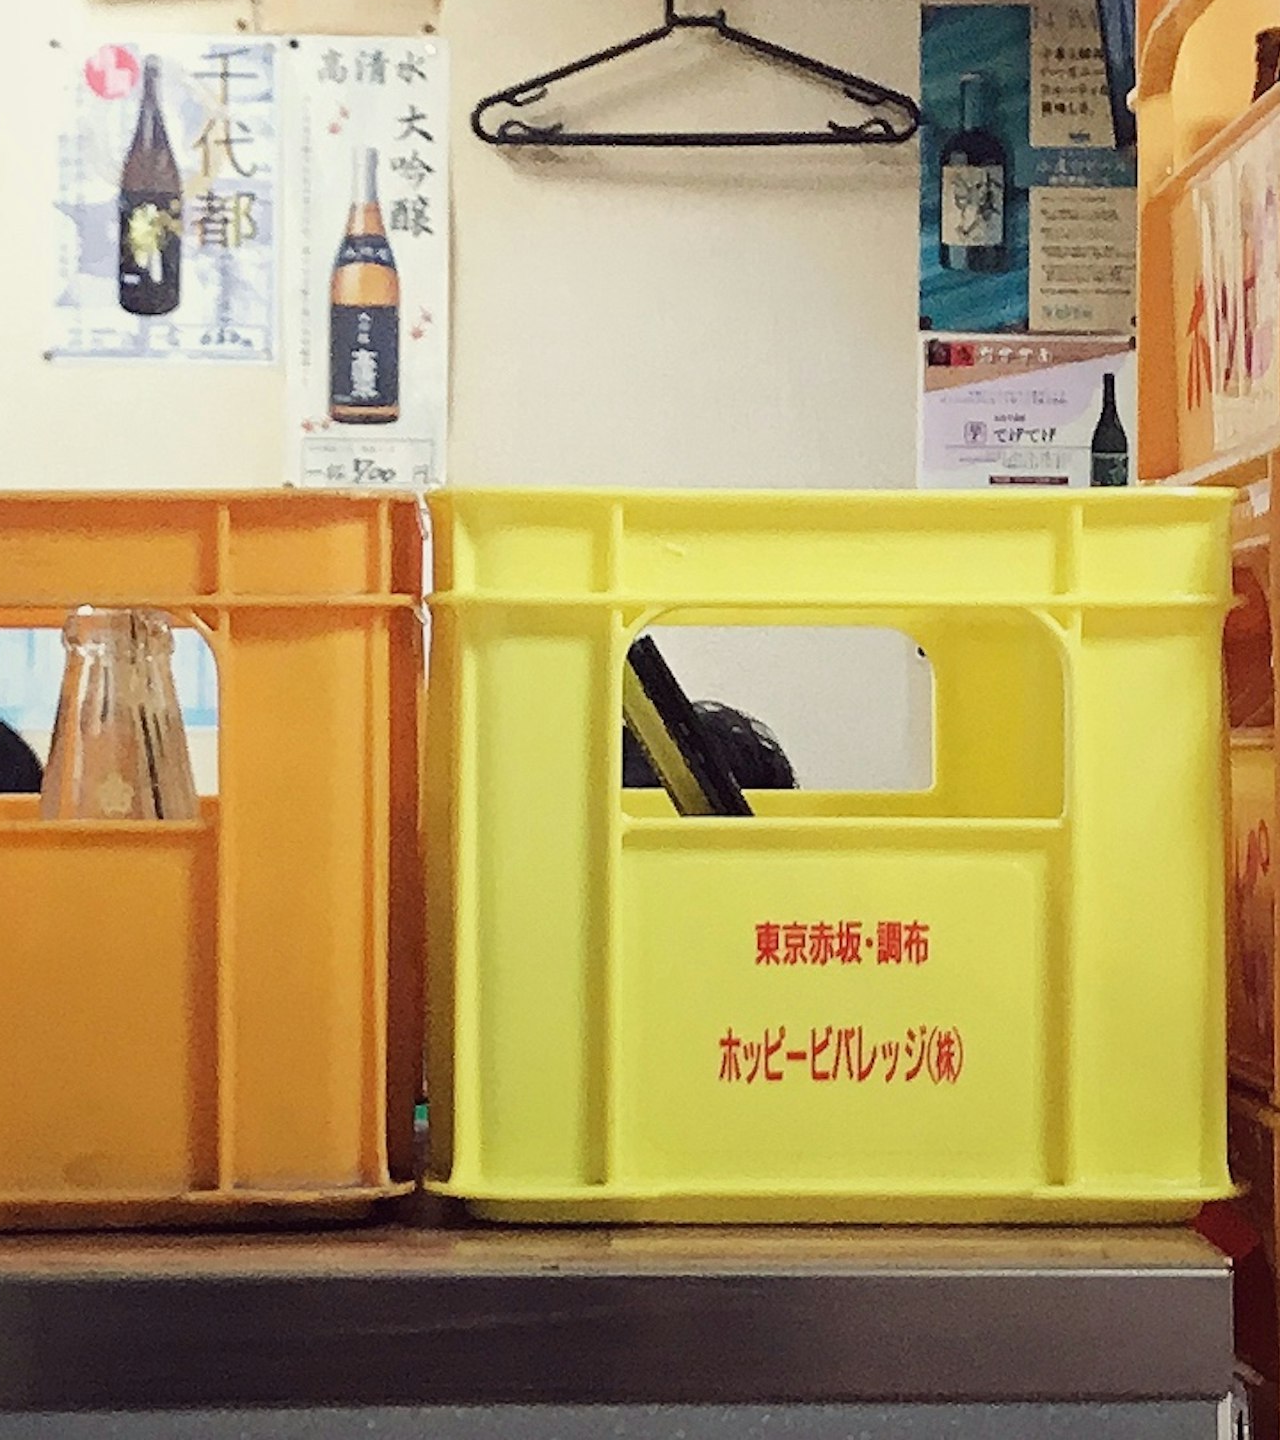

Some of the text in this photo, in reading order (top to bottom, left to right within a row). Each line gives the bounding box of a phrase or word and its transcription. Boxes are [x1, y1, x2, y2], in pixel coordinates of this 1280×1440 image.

[318, 49, 428, 86] 高清水
[754, 920, 930, 966] 東京赤坂・調布
